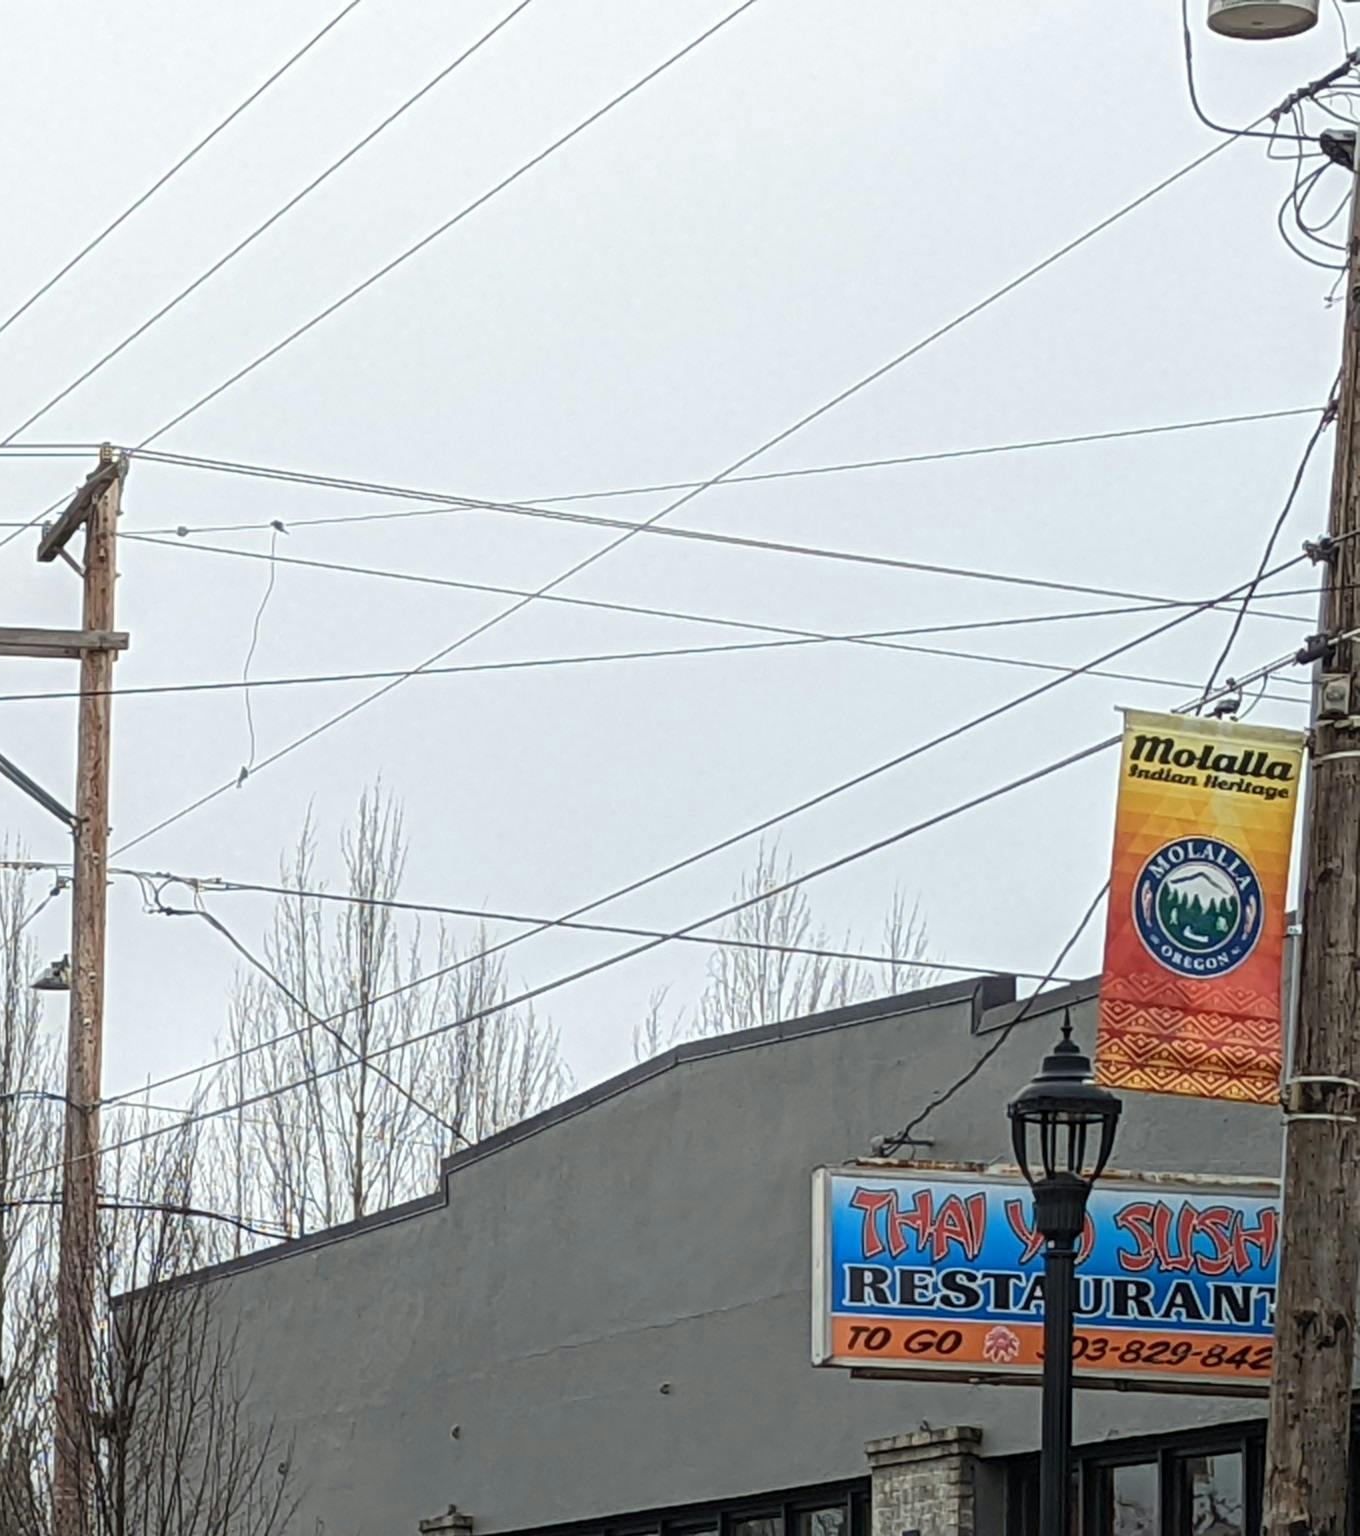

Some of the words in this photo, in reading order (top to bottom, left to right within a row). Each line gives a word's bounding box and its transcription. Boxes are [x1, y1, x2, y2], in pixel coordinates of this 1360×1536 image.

[1130, 734, 1295, 782] Molalla
[1128, 763, 1198, 787] Indian
[1203, 774, 1290, 801] Heritage
[1148, 841, 1252, 892] MOLALLA
[1160, 943, 1230, 971] OREGON
[851, 1186, 987, 1262] THAI
[1115, 1200, 1279, 1276] SUSH
[847, 1325, 891, 1352] TO
[903, 1329, 963, 1355] GO
